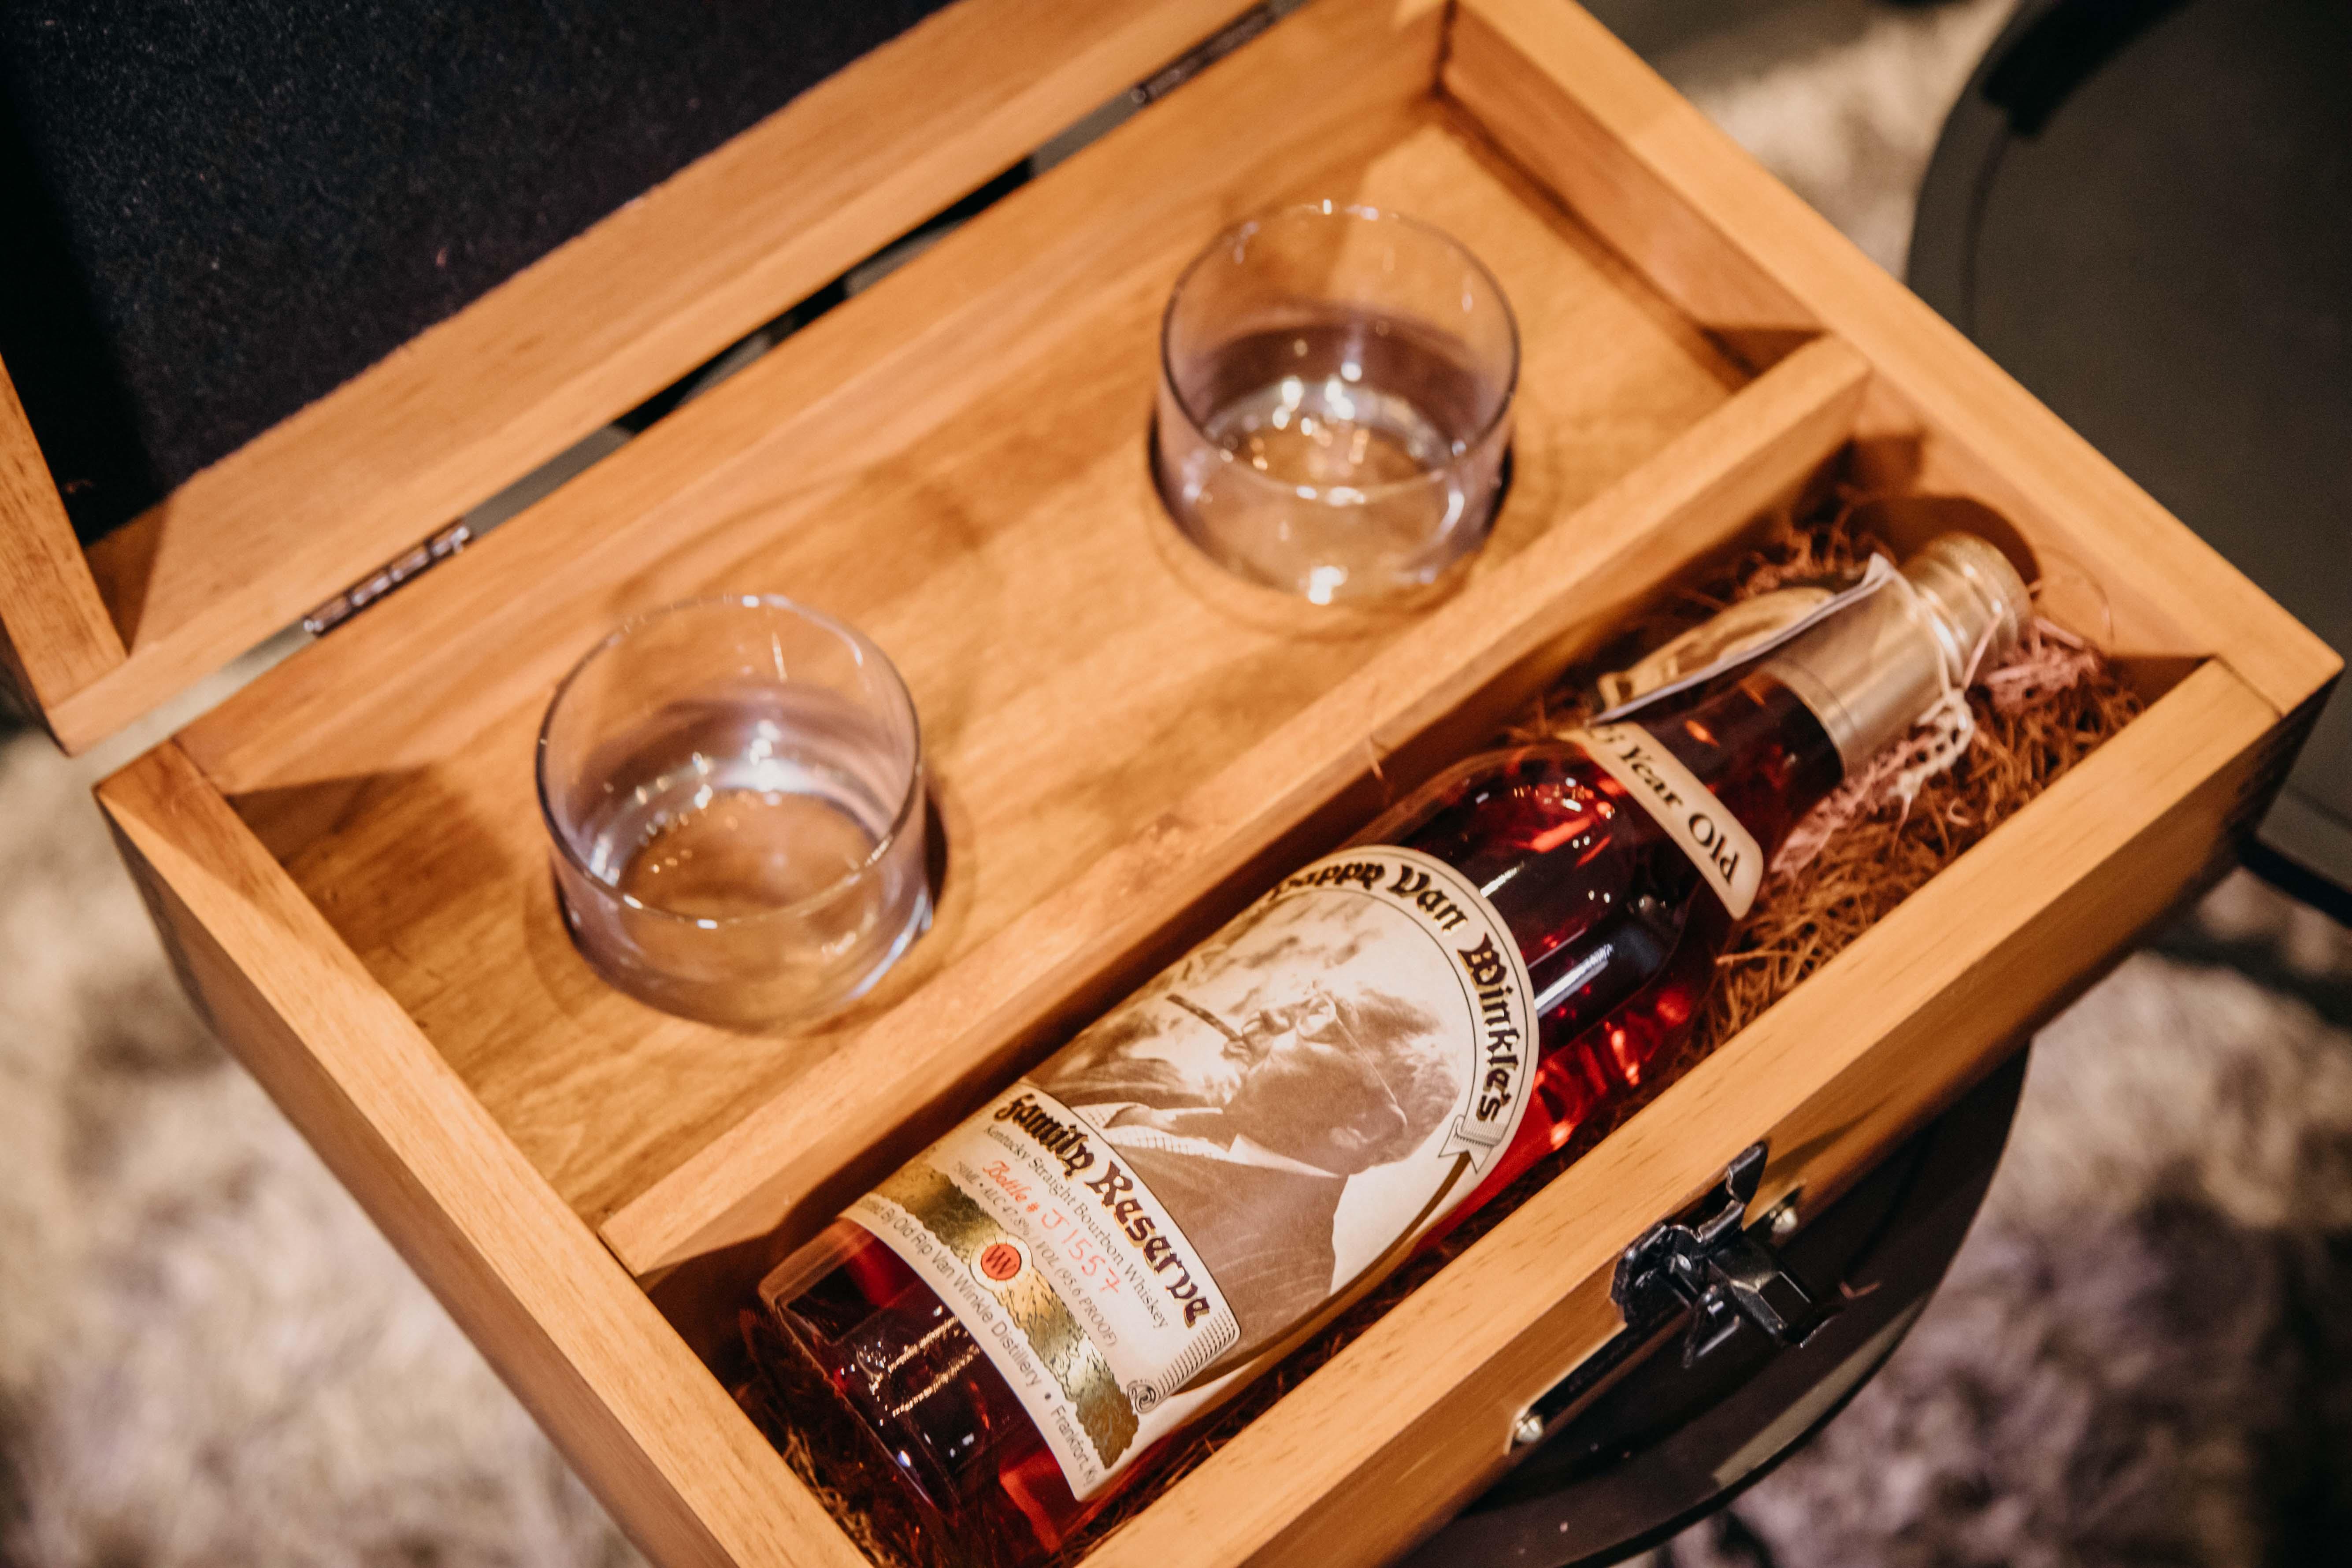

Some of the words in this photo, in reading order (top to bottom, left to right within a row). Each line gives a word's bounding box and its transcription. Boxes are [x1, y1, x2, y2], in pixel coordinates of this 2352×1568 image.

[1619, 745, 1683, 807] Year
[1688, 813, 1740, 886] Old
[1386, 864, 1469, 934] Van
[1457, 932, 1520, 1121] Winkle's
[983, 1160, 1031, 1202] Bottle
[994, 1093, 1094, 1180] Family
[1083, 1160, 1209, 1329] Reserve
[1028, 1157, 1076, 1206] Straight
[1074, 1198, 1124, 1267] Bourbon
[1124, 1264, 1168, 1329] Whiskey
[893, 1217, 916, 1238] Old
[911, 1231, 933, 1255] Rip
[932, 1250, 955, 1279] Van
[954, 1273, 993, 1323] Winkle
[991, 1321, 1042, 1387] Distillery
[1079, 1297, 1117, 1347] PROOF)
